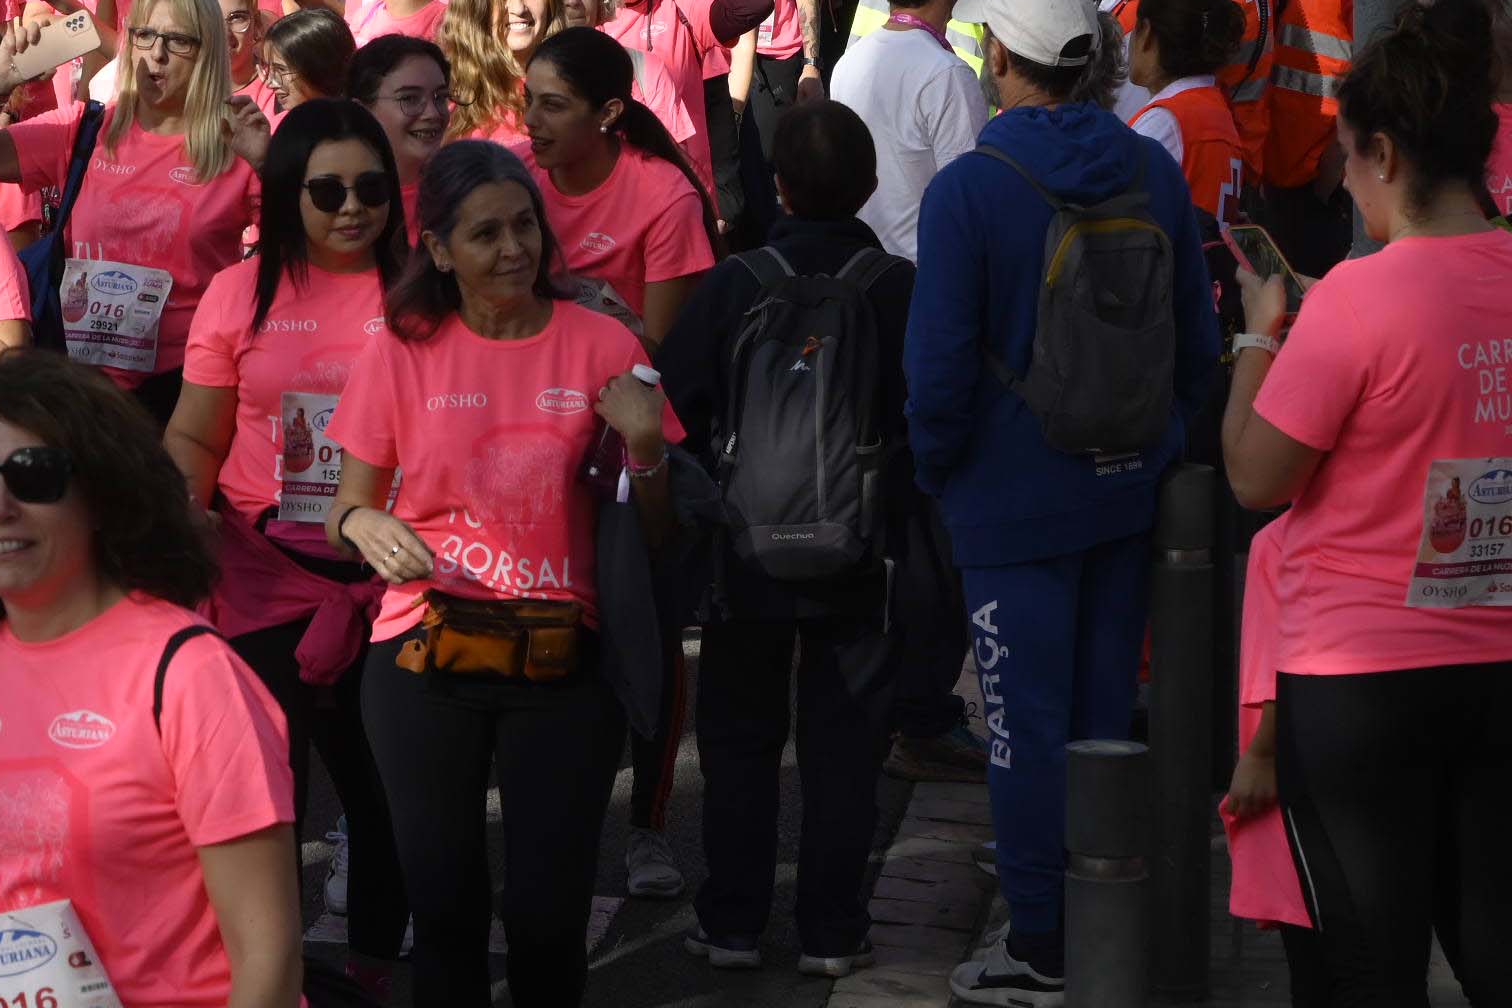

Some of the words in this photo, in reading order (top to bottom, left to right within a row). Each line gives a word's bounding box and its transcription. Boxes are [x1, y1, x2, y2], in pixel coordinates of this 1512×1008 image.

[90, 301, 125, 319] 016
[90, 319, 119, 332] 29921
[1479, 367, 1508, 395] DE
[427, 392, 488, 412] OYSHO
[1470, 543, 1505, 558] 33157
[972, 599, 1012, 770] BARÇA
[54, 724, 115, 742] ASTURIANA
